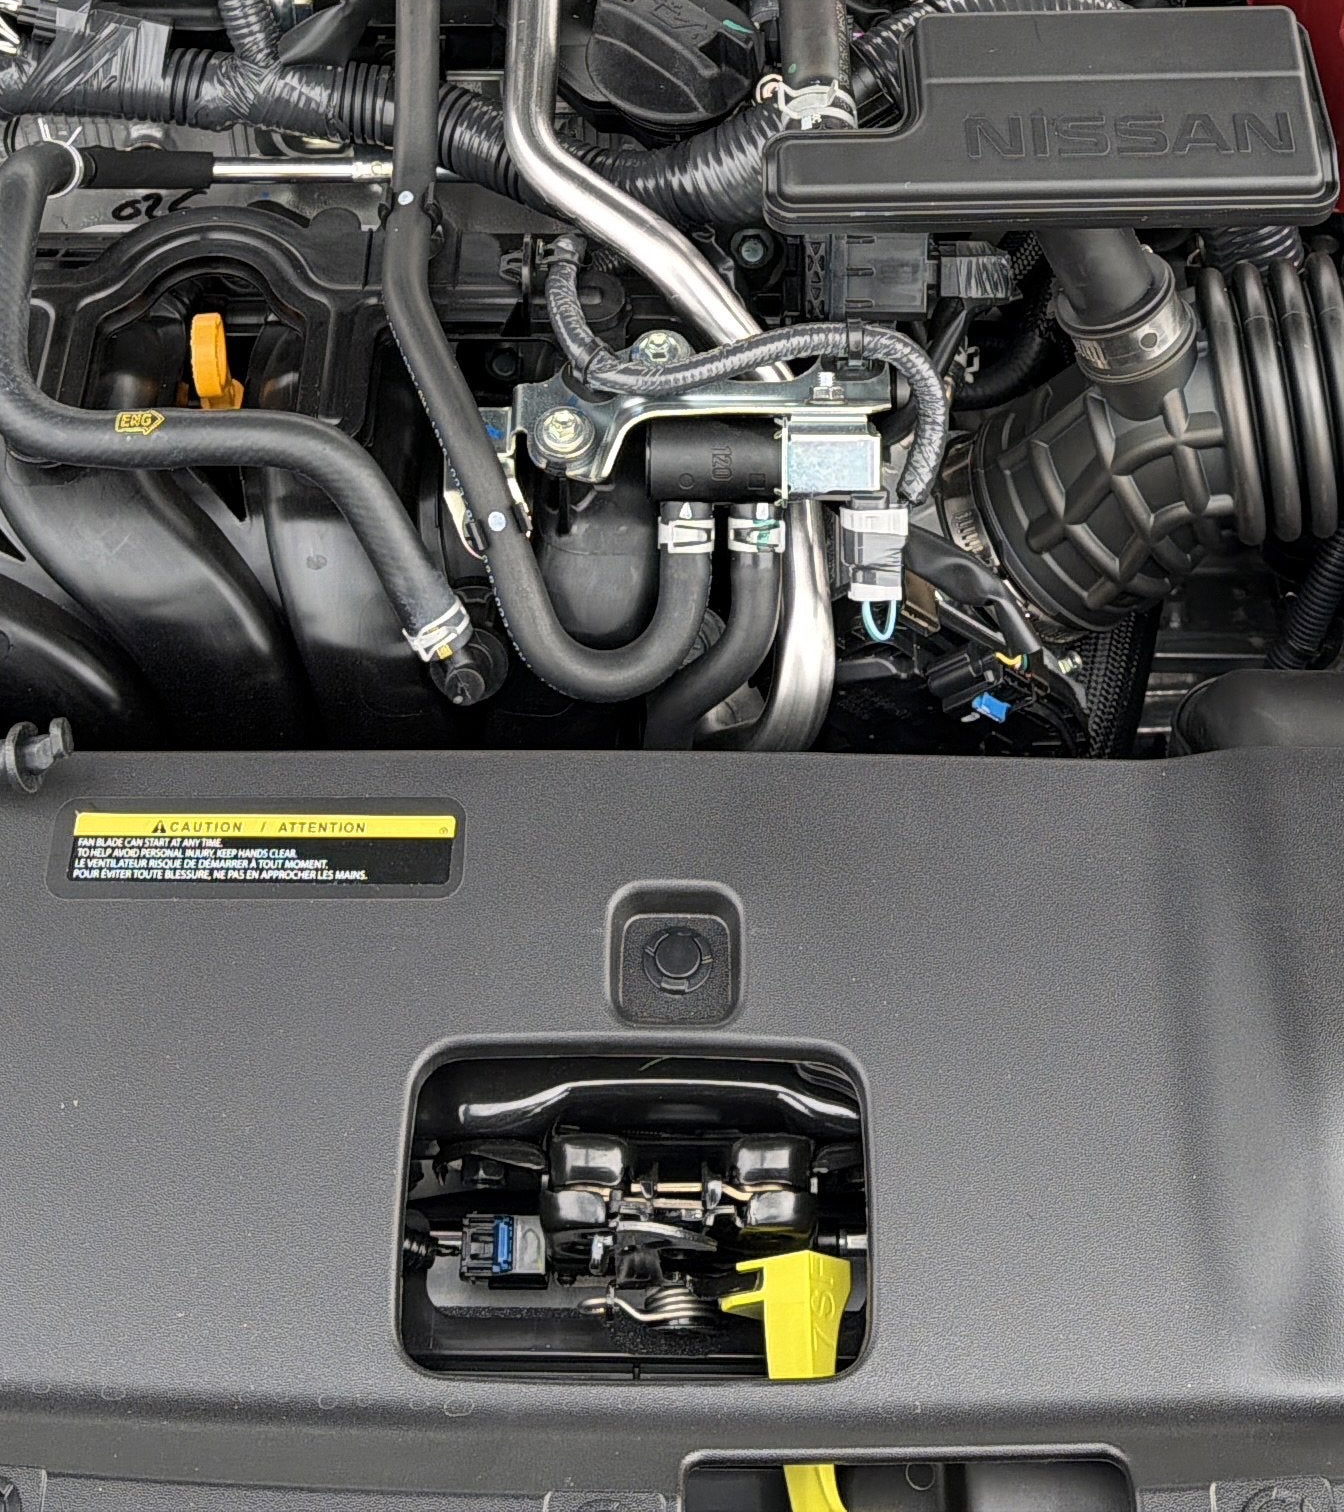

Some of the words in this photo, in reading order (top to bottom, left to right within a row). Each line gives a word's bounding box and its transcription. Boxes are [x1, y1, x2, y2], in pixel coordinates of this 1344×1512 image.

[962, 111, 1298, 160] NISSAN
[120, 413, 152, 428] ENG
[170, 821, 243, 833] CAUTION
[278, 822, 366, 834] ATTENTION
[78, 838, 95, 847] FAN
[96, 838, 123, 847] BLADE
[125, 838, 143, 848] CAN
[144, 838, 169, 848] START
[170, 838, 182, 848] AT
[182, 838, 202, 848] ANY
[77, 848, 90, 858] TO
[90, 848, 112, 858] HELP
[113, 848, 140, 858] AVOID
[141, 848, 183, 859] PERSONAL
[217, 849, 237, 858] KEEP
[238, 849, 268, 859] HANDS
[74, 858, 86, 868] LE
[87, 858, 147, 868] VENTILATEUR
[148, 859, 182, 869] RISQUE
[183, 859, 196, 869] DE
[198, 858, 249, 869] DÉMARRER
[258, 859, 283, 869] TOUT
[284, 859, 328, 870] MOMENT.
[73, 869, 100, 879] POUR
[101, 868, 132, 879] ÉVITER
[133, 869, 163, 879] TOUTE
[213, 869, 226, 880] NE
[227, 870, 245, 880] PAS
[246, 870, 260, 880] EN
[260, 869, 317, 880] APPROCHER
[317, 870, 334, 880] LES
[335, 870, 368, 880] MAINS.
